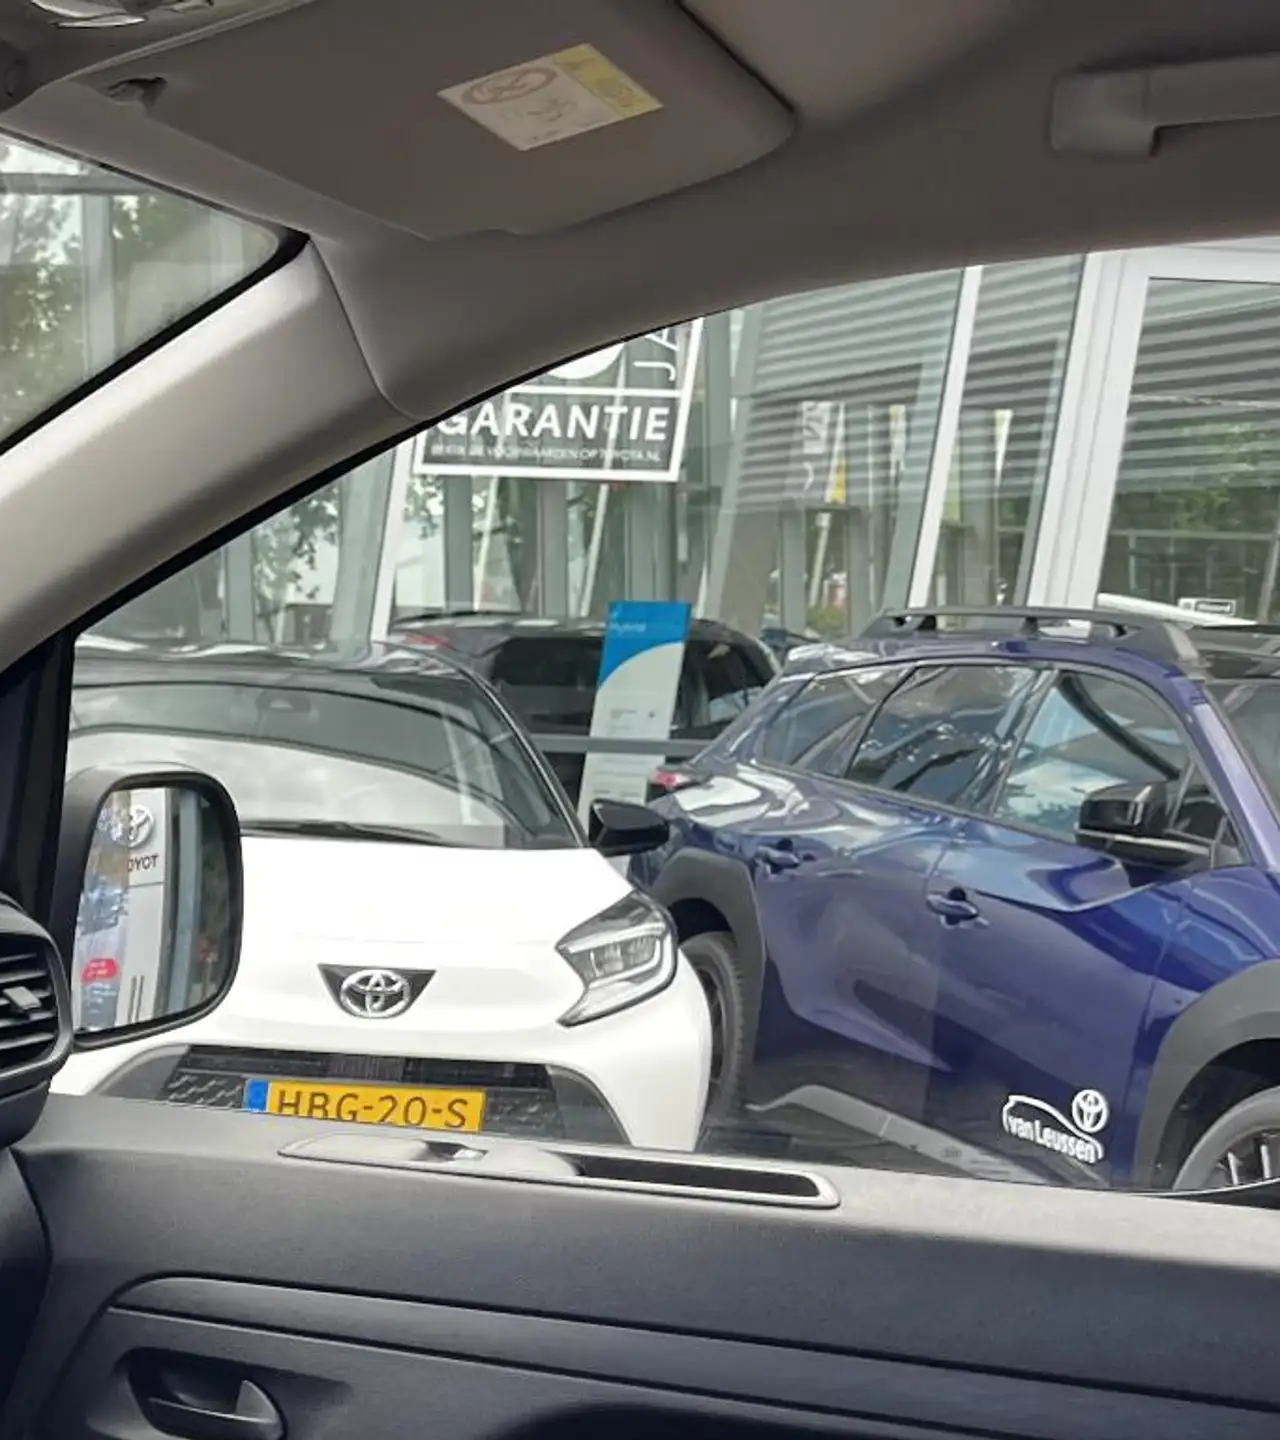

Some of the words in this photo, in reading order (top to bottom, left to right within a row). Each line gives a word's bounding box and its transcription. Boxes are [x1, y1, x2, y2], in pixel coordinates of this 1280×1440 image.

[439, 401, 670, 442] GARANTIE
[277, 1089, 469, 1129] HBG-20-S
[1035, 1119, 1096, 1164] Leussen
